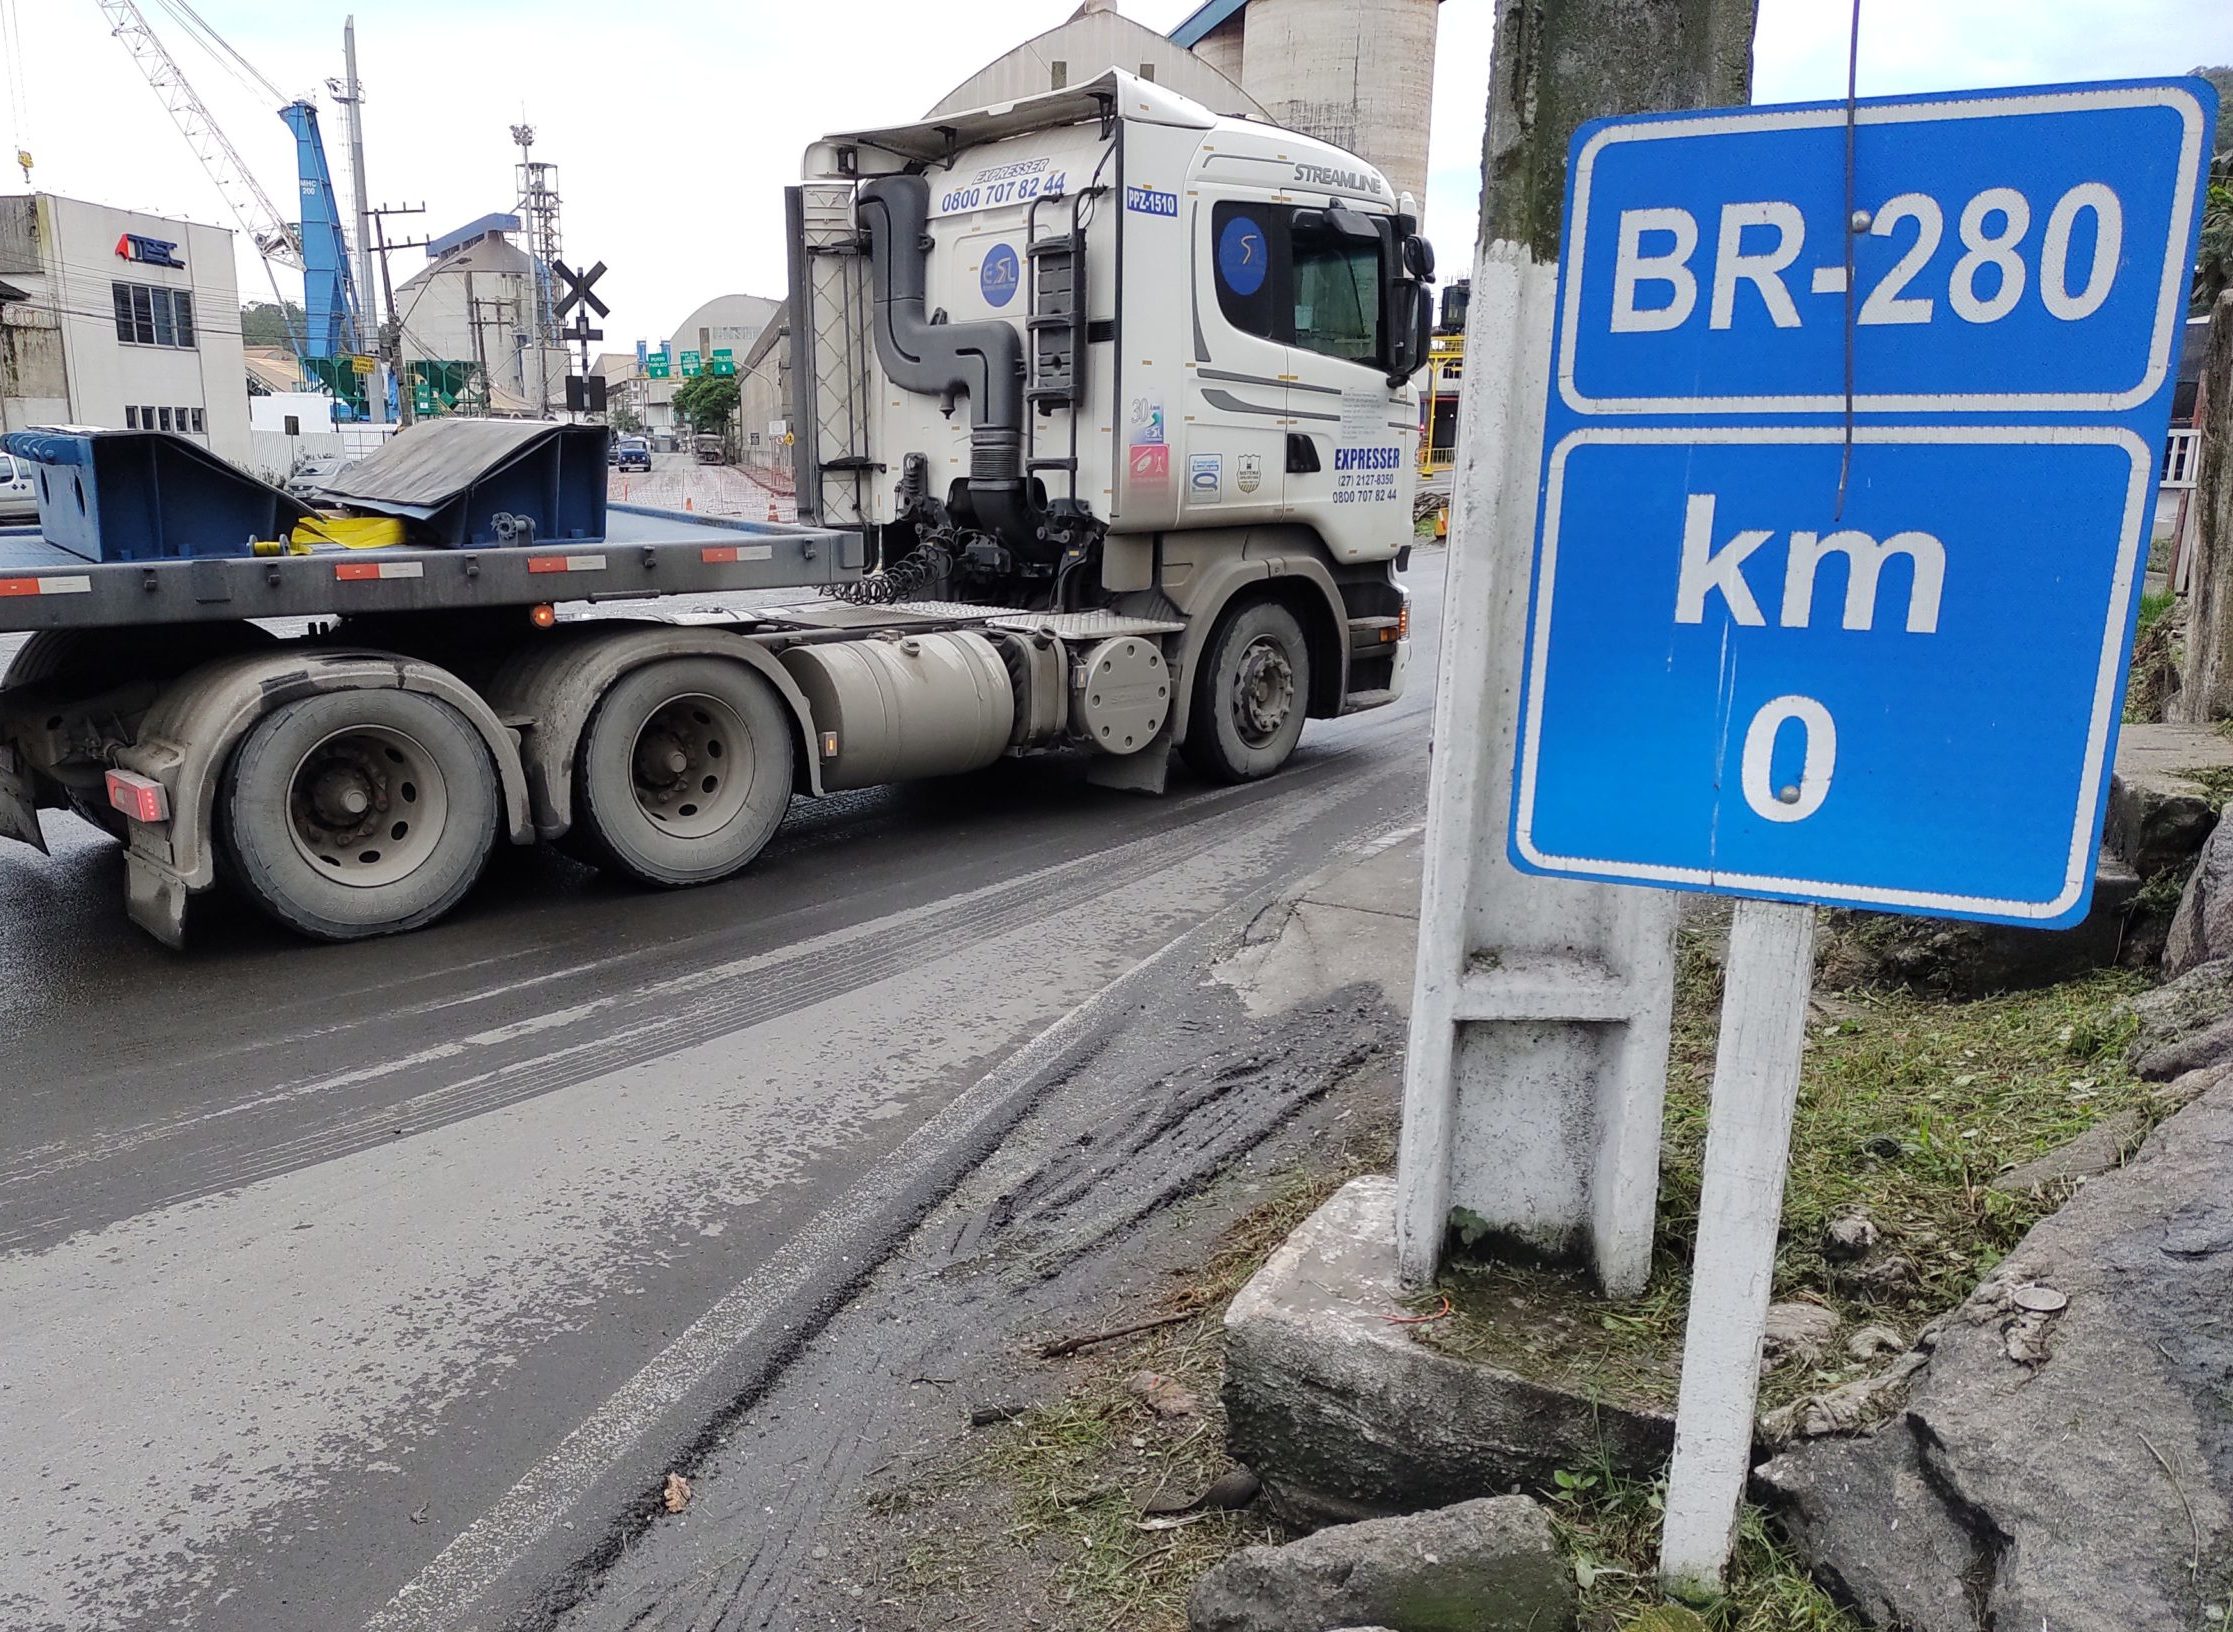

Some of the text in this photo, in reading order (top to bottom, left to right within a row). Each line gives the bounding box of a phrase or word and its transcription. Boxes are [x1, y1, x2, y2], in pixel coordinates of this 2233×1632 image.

[971, 158, 1049, 186] EXPRESSER
[1294, 163, 1381, 194] STREAMLINE
[302, 187, 316, 195] 200
[942, 172, 1066, 212] 0800 707 82 44
[1128, 189, 1175, 214] PPZ-1510
[1609, 181, 2123, 333] BR-280
[1131, 398, 1149, 424] 30
[1334, 447, 1400, 470] EXPRESSER
[1338, 473, 1394, 487] (27) 2127-8350
[1332, 488, 1397, 503] 0800 707 82 44
[1674, 494, 1946, 633] km
[1741, 695, 1837, 823] 0
